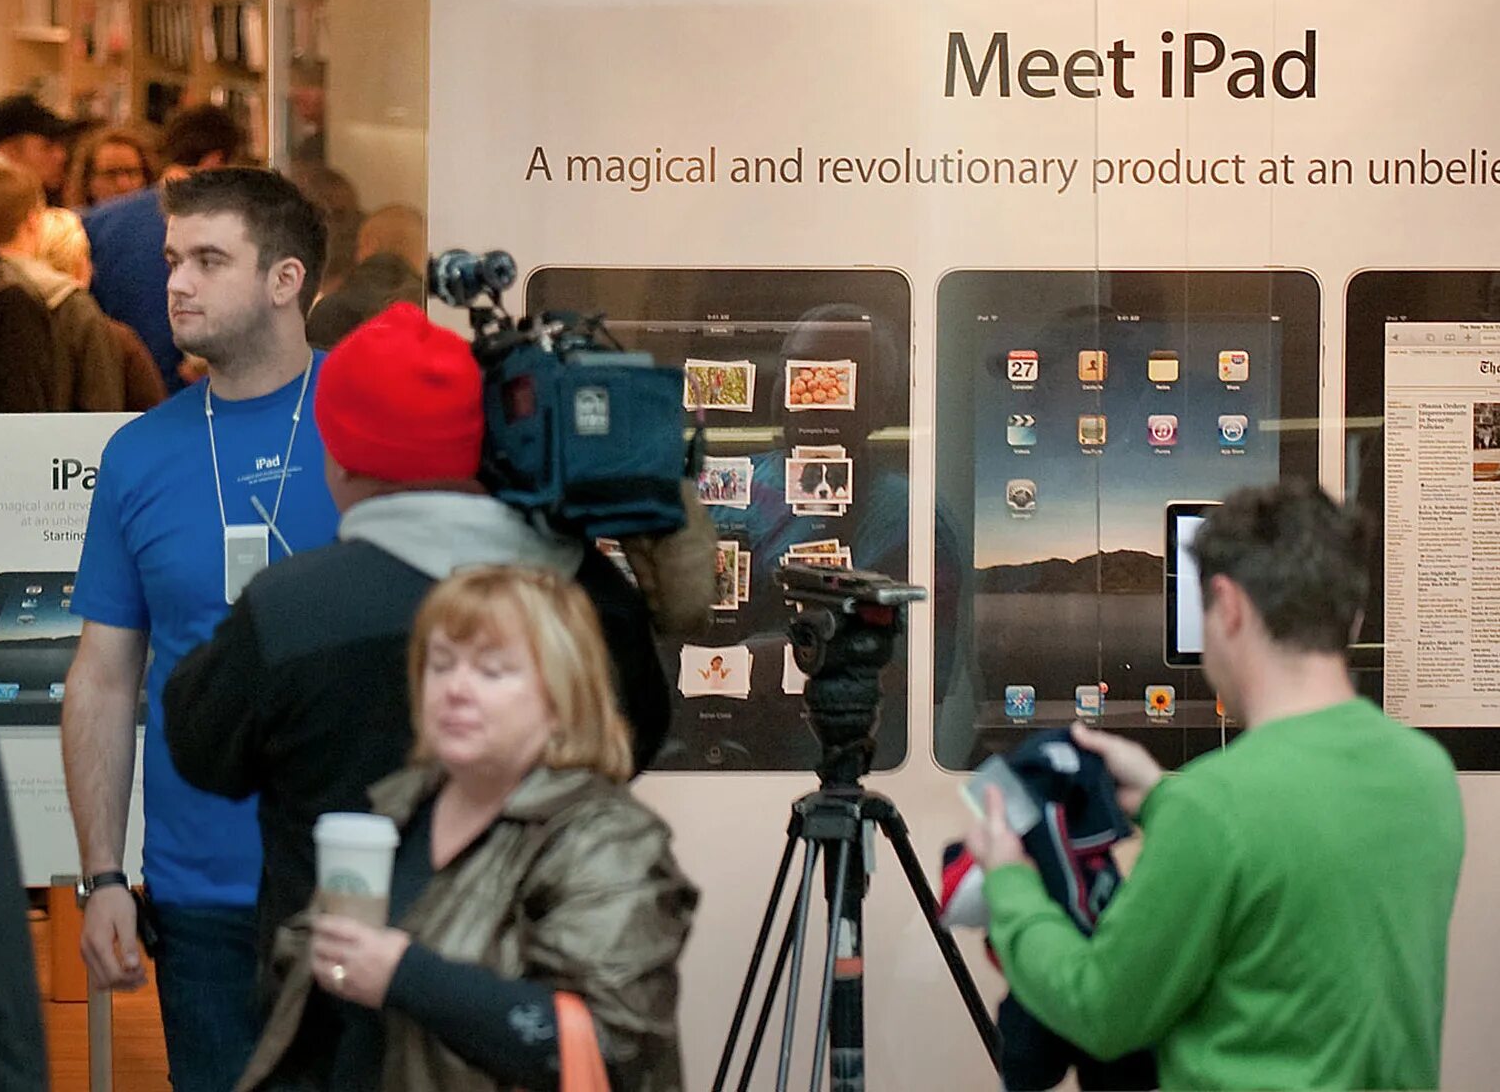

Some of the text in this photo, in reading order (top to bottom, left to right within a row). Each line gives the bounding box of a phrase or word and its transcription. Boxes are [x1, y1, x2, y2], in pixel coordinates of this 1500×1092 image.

[944, 29, 1318, 100] Meet iPad
[526, 146, 1500, 195] A magical and revolutionary product at an unbelie
[1012, 362, 1034, 377] 27
[255, 454, 281, 470] iPad
[52, 458, 99, 490] iPa
[44, 499, 65, 511] and
[21, 516, 32, 526] at
[35, 517, 49, 526] an
